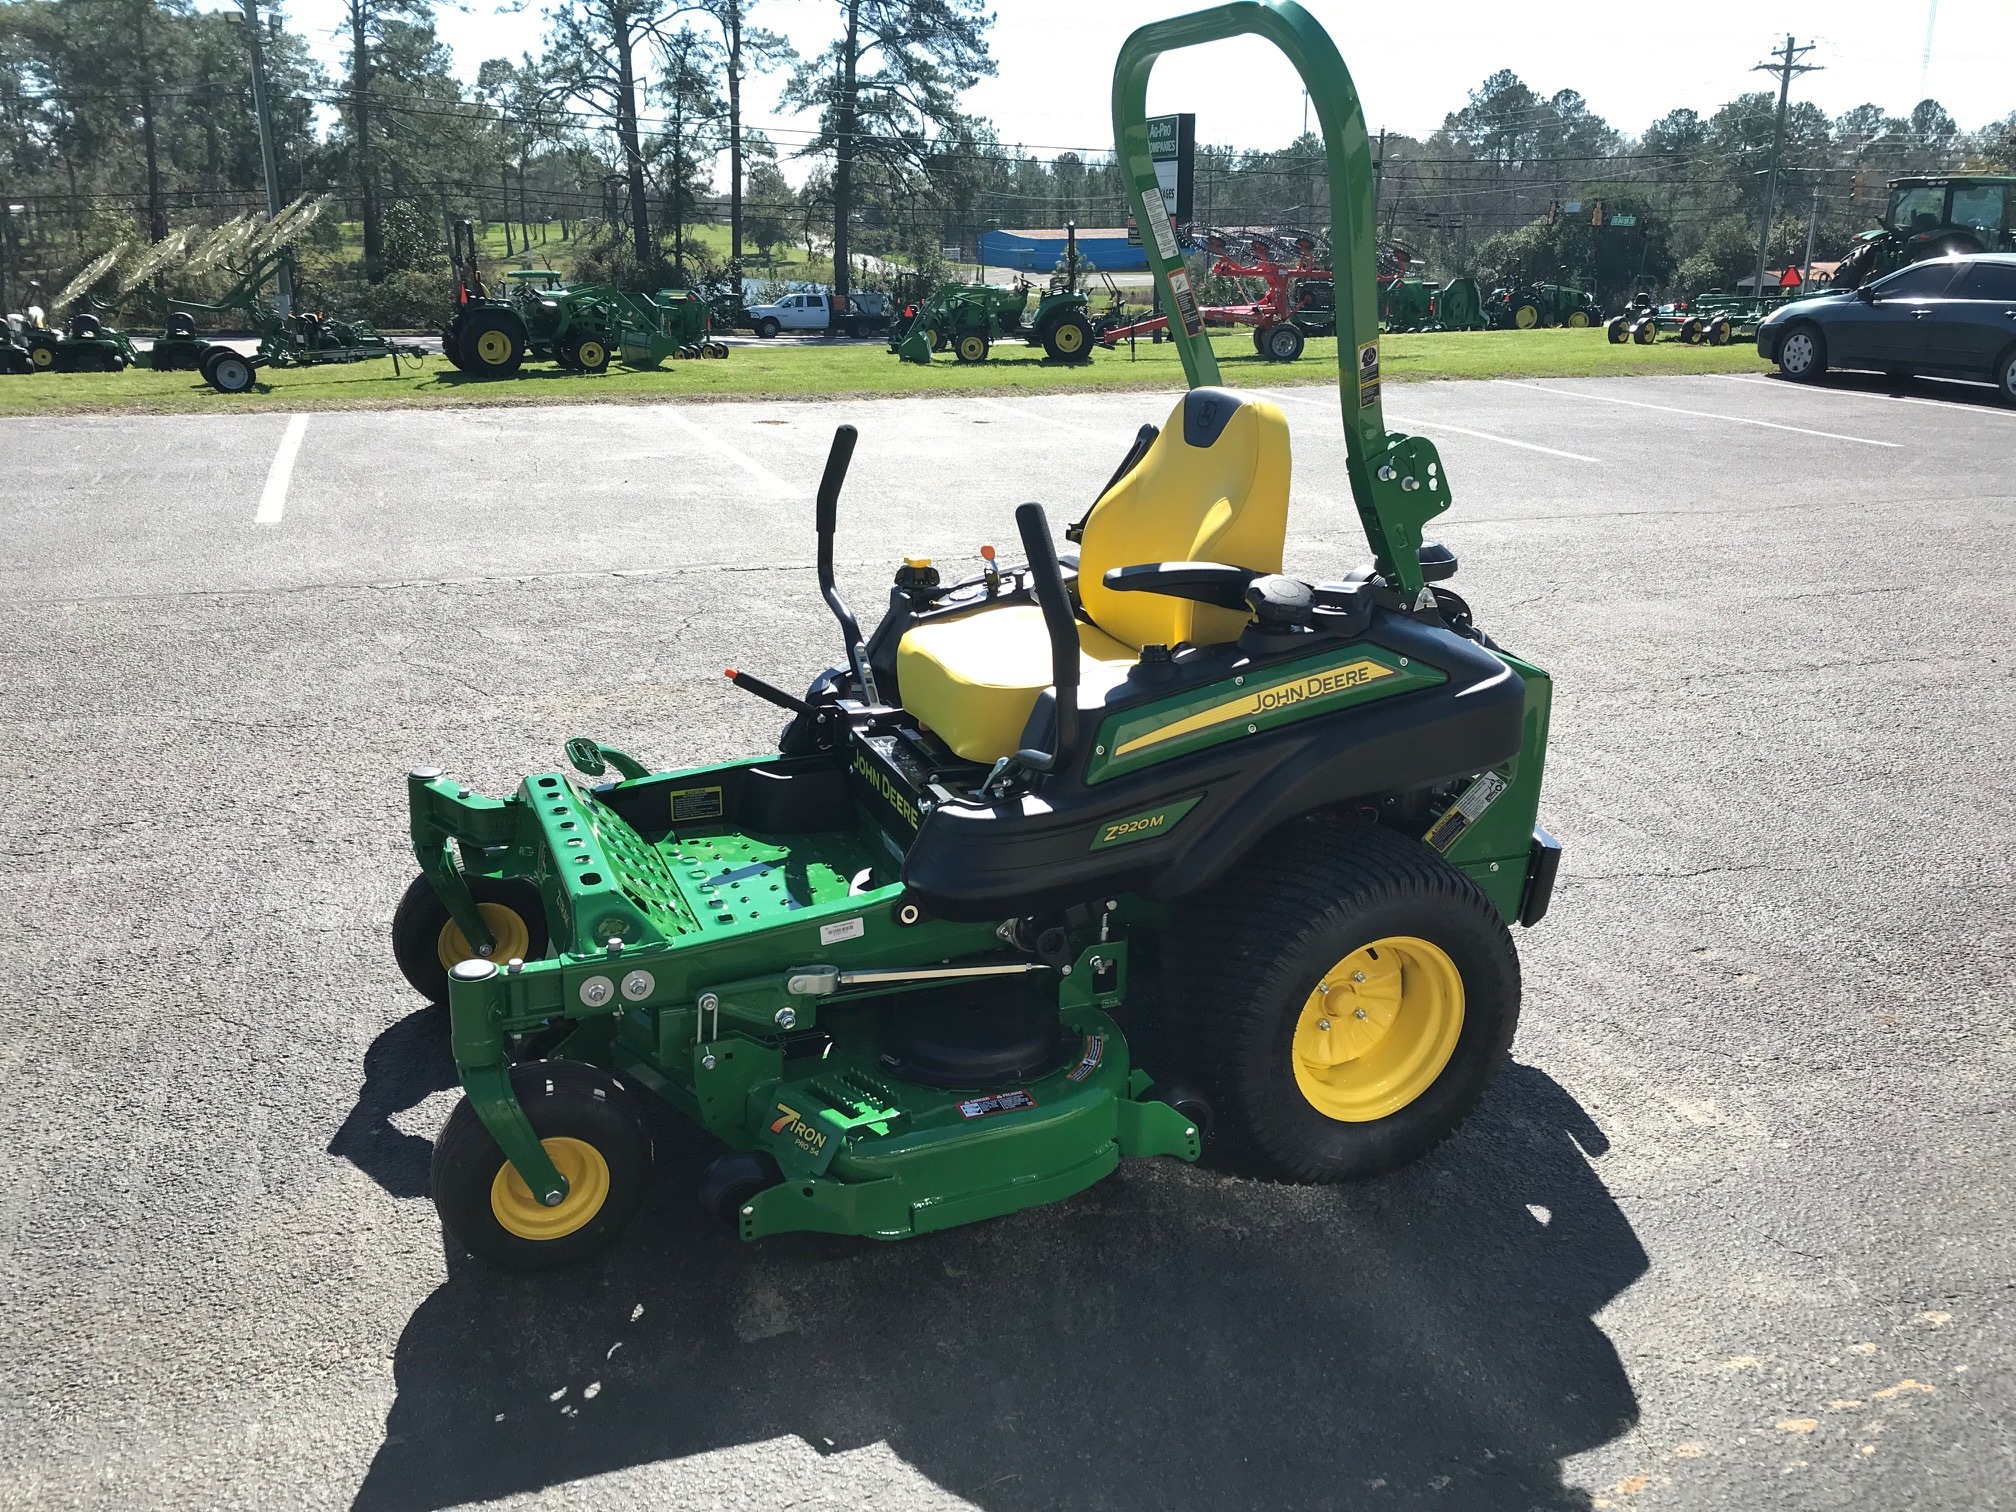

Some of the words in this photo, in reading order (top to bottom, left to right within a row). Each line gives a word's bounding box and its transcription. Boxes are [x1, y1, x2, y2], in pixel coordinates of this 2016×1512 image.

[1150, 139, 1176, 154] OMPANIES
[1252, 685, 1303, 713] JOHN
[1307, 666, 1370, 696] DEERE
[853, 748, 880, 791] JOHN
[881, 773, 918, 831] DEERE
[1103, 814, 1165, 842] Z920M
[794, 1138, 810, 1151] PRO
